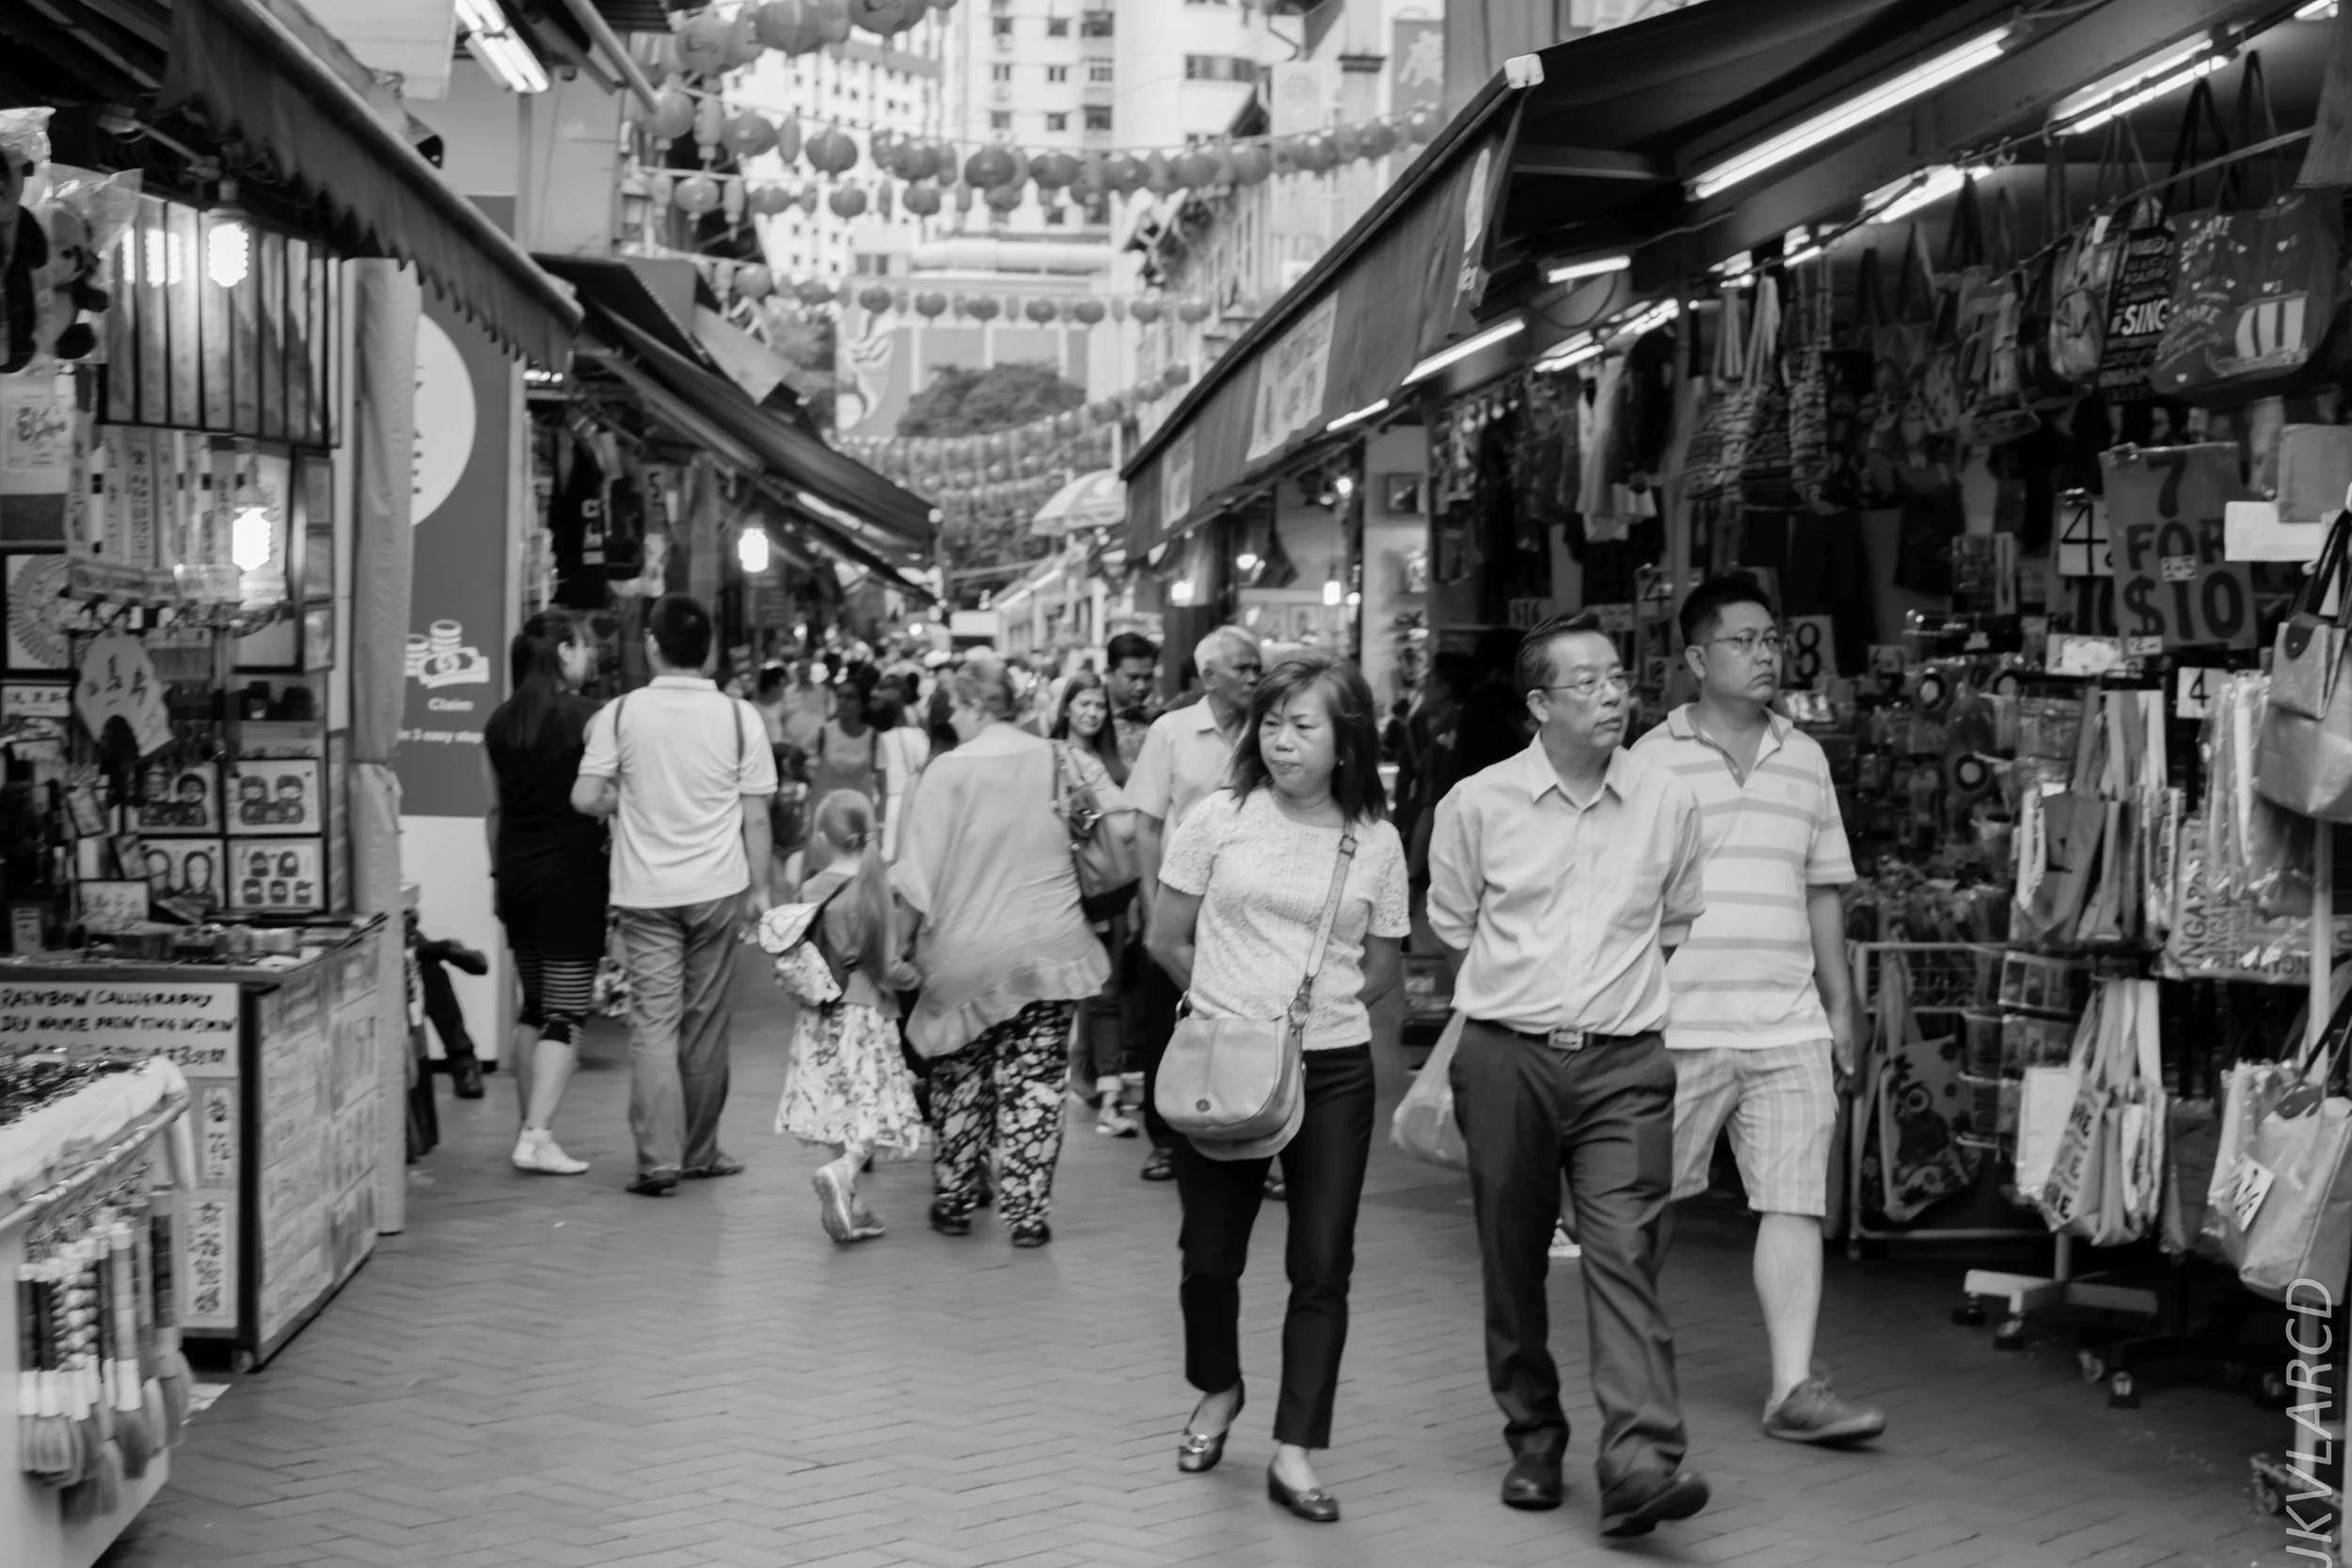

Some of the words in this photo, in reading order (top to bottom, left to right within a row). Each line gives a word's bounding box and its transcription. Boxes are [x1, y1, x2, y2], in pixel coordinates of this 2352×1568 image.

[2146, 451, 2187, 517] 7
[2122, 569, 2245, 641] $10
[1795, 622, 1820, 680] 8
